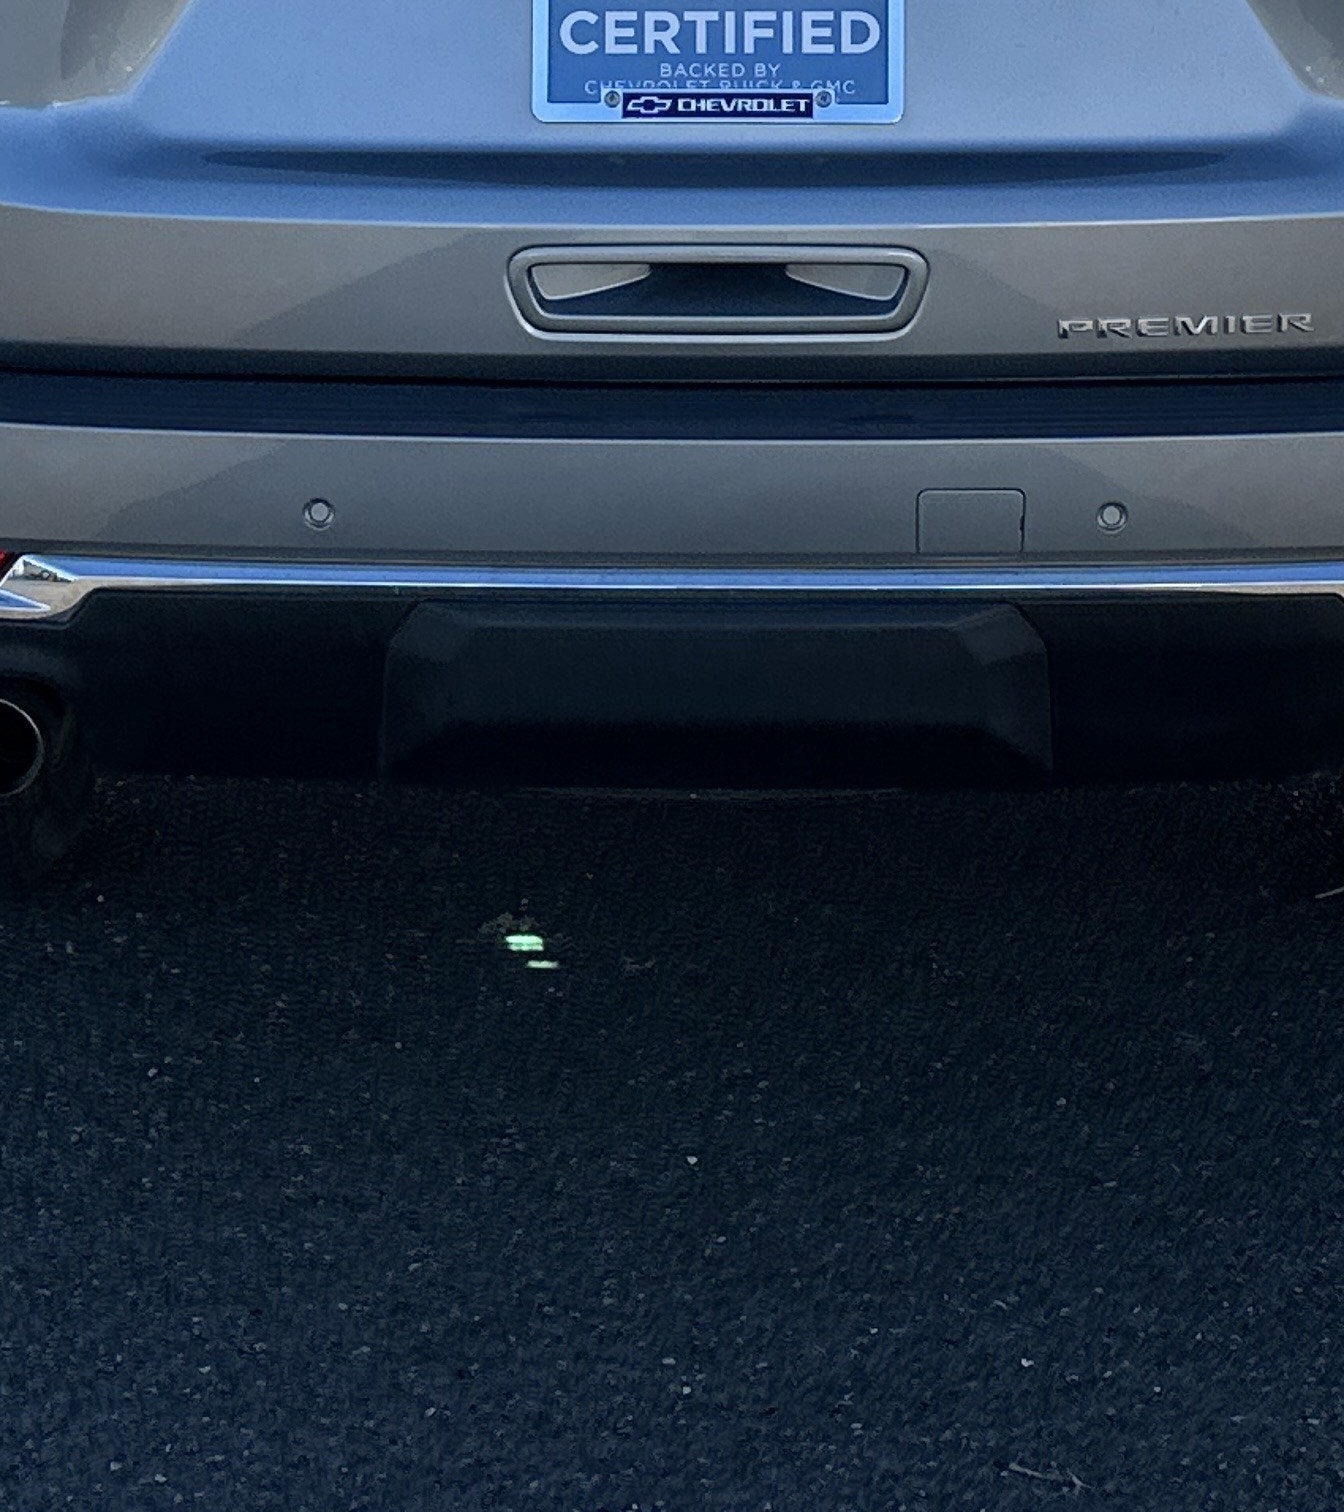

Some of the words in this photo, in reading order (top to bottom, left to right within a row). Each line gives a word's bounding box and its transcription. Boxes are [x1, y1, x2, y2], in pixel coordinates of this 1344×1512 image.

[559, 10, 881, 55] CERTIFIED
[660, 62, 746, 78] BACKED
[754, 62, 781, 78] BY
[677, 98, 810, 112] CHEVROLET
[1058, 313, 1314, 338] PREMIER
